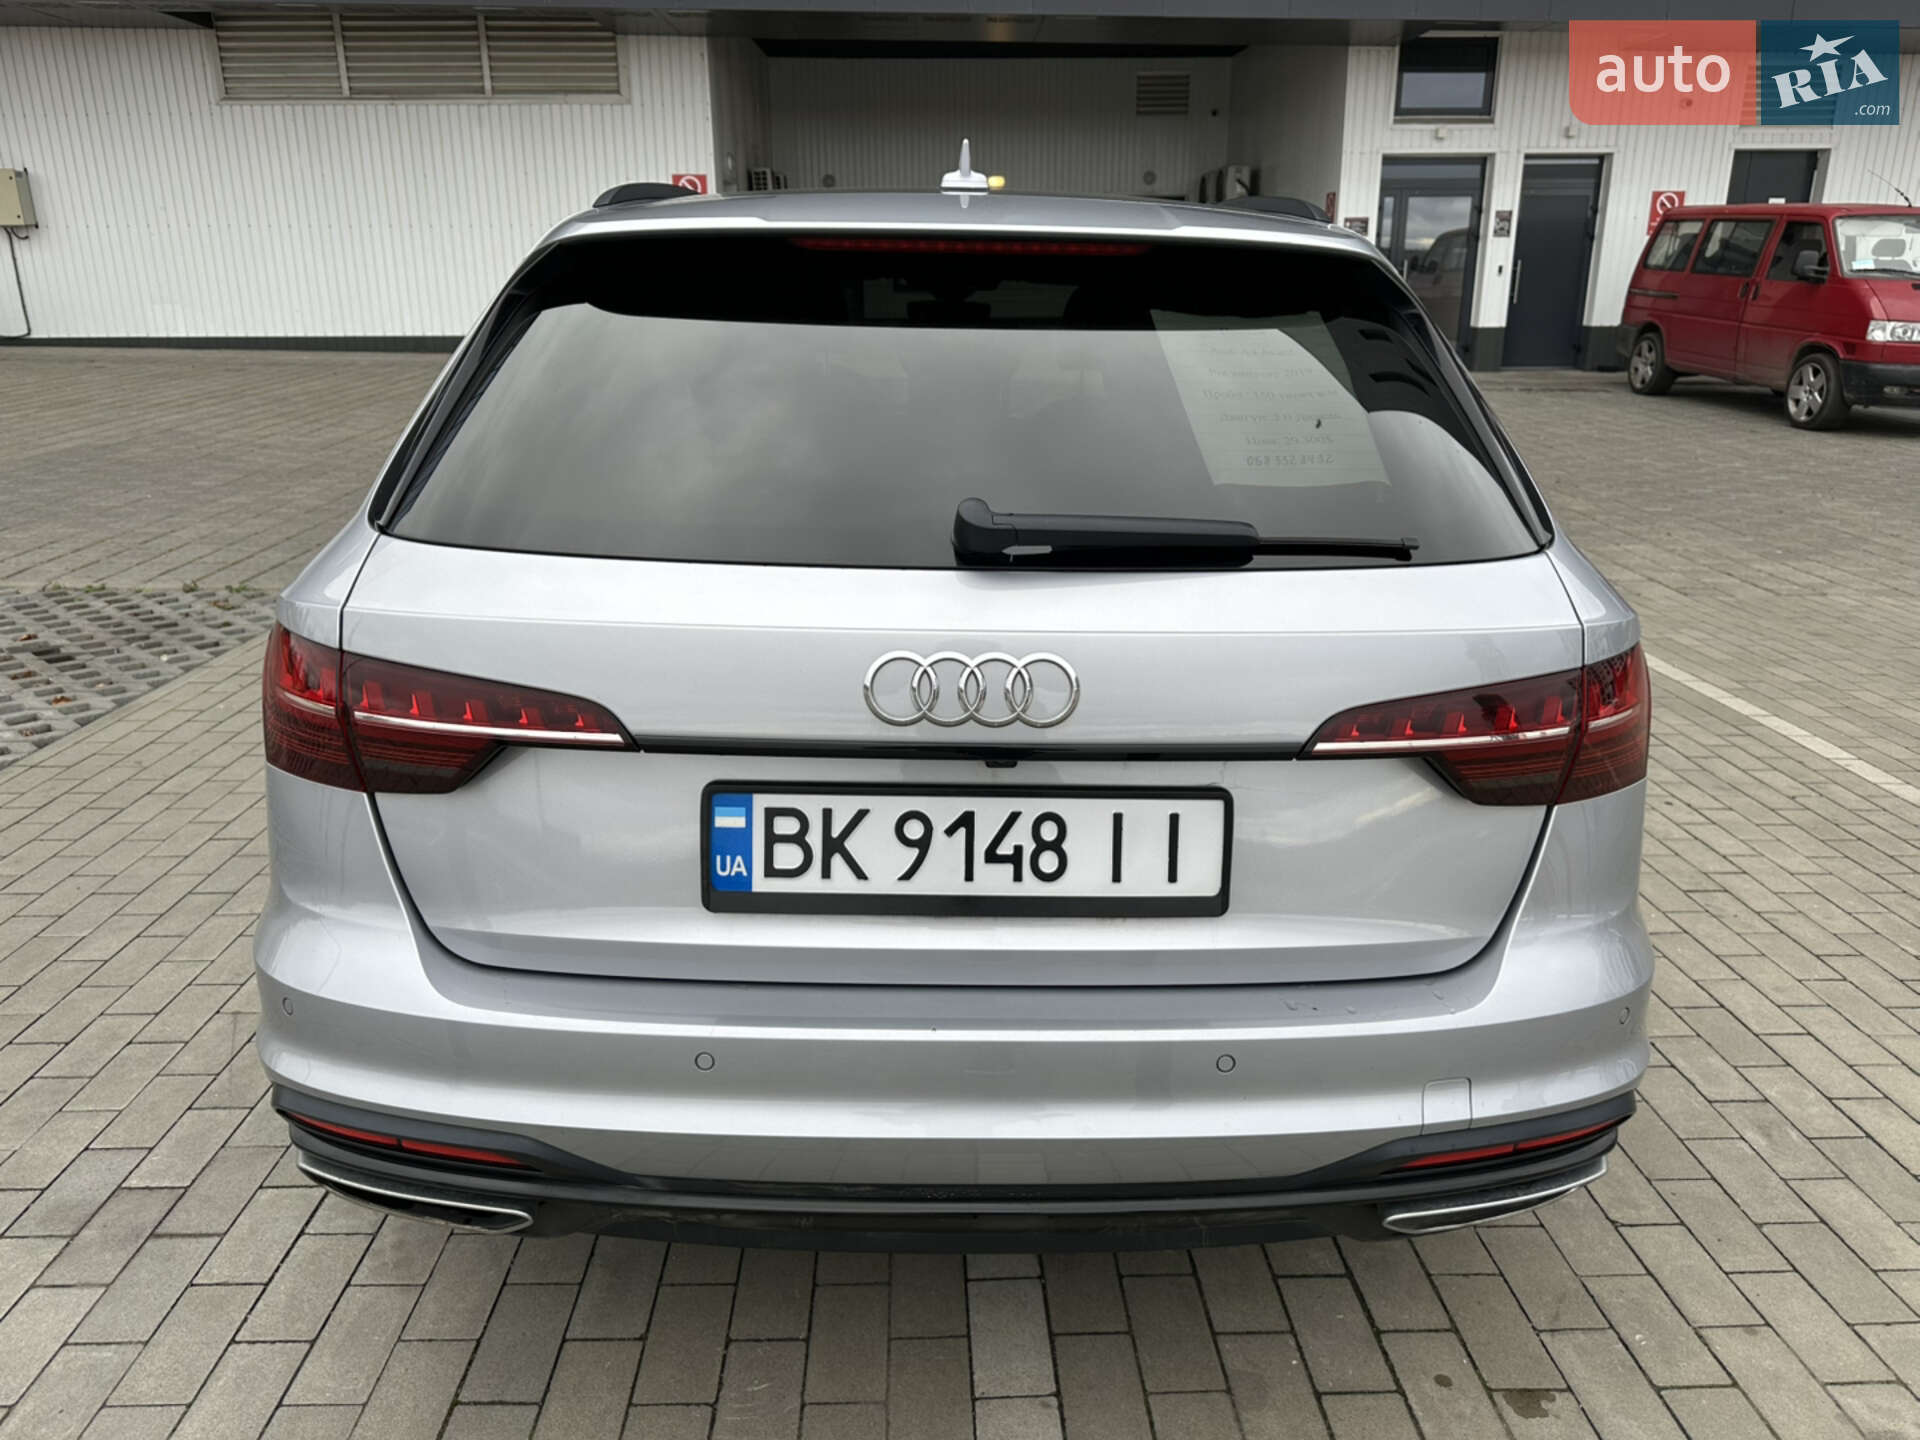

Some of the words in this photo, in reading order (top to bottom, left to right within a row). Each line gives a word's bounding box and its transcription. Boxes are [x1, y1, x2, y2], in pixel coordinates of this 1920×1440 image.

[716, 856, 748, 877] UA
[763, 807, 871, 881] BK
[895, 810, 1069, 883] 9148
